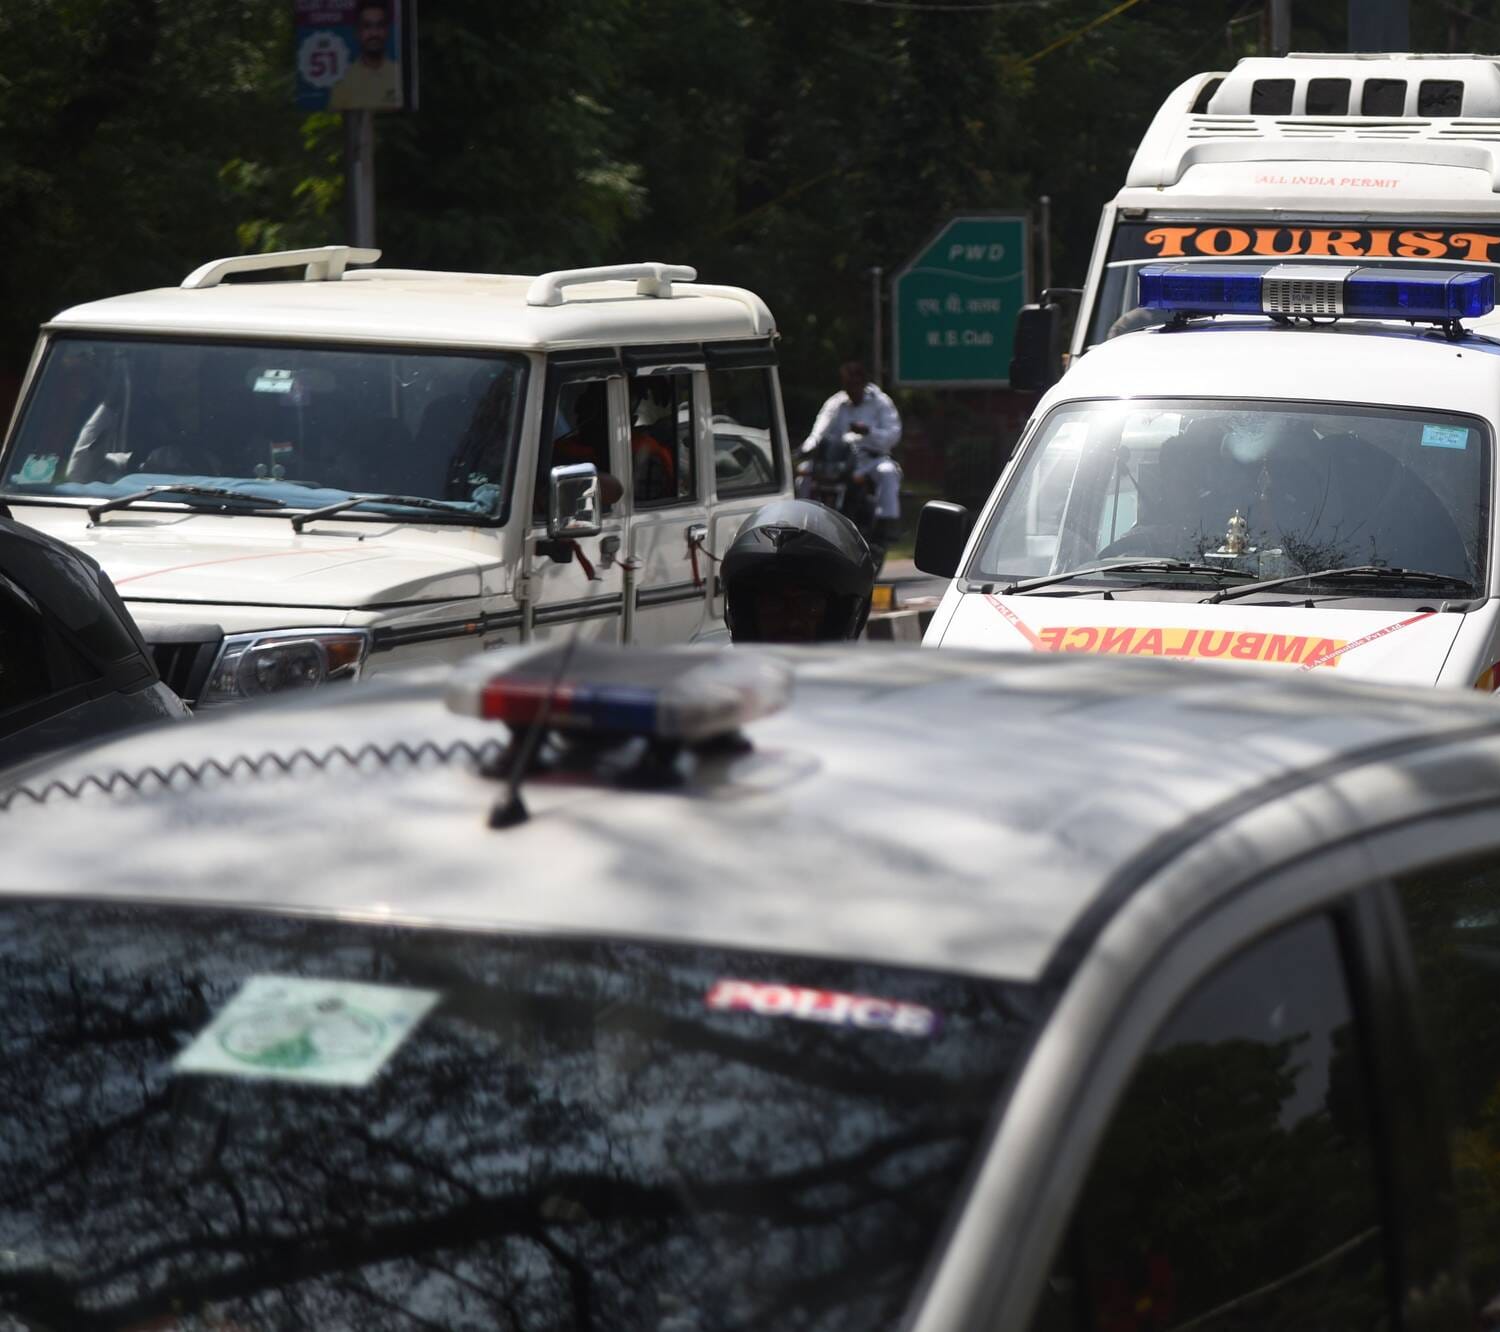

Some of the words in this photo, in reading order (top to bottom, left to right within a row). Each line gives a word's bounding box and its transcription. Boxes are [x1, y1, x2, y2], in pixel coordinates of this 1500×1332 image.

[1291, 175, 1335, 187] INDIA
[1340, 178, 1400, 189] PERMIT
[709, 980, 934, 1036] POLICE
